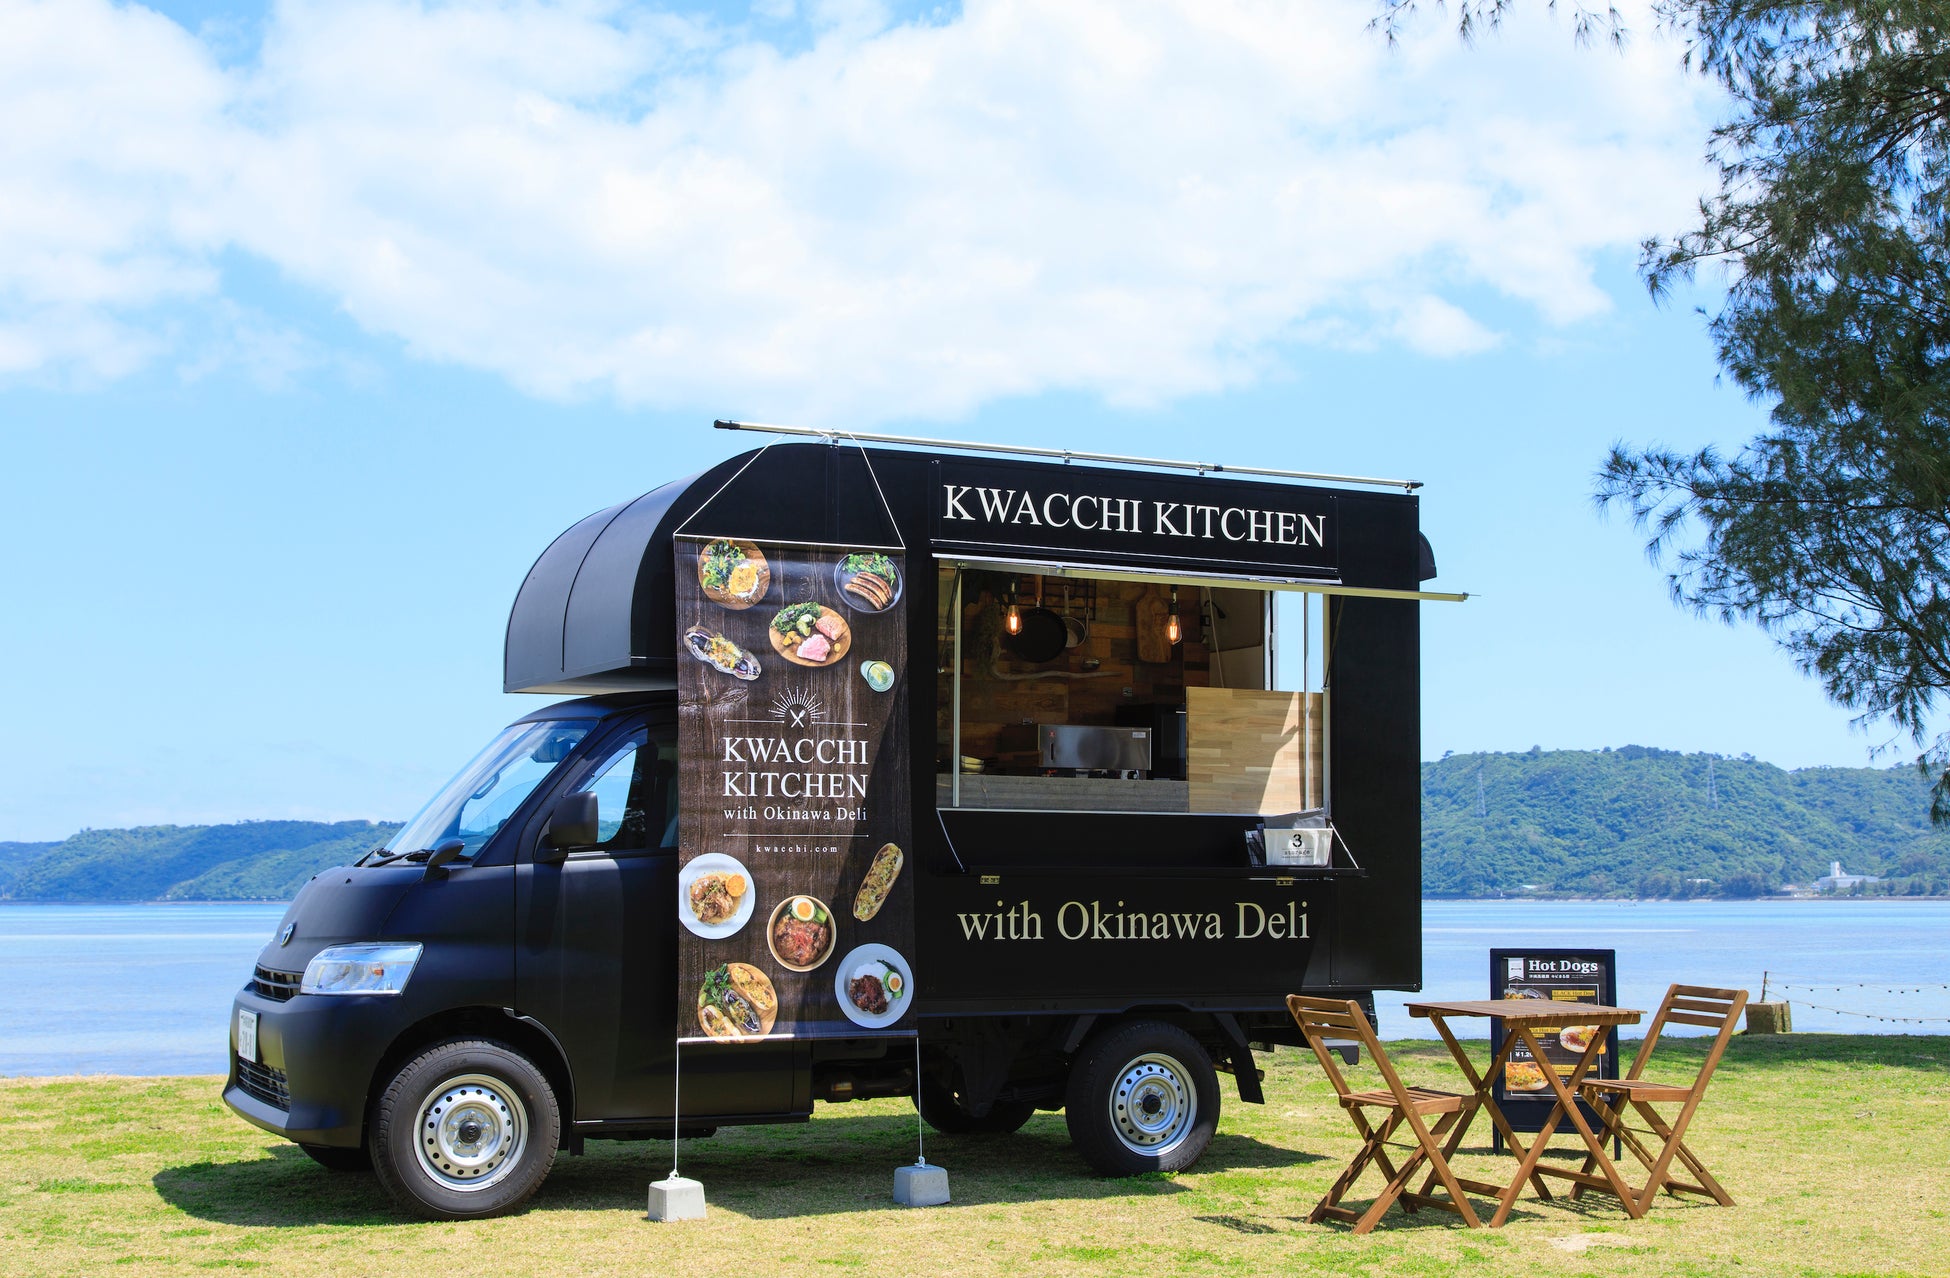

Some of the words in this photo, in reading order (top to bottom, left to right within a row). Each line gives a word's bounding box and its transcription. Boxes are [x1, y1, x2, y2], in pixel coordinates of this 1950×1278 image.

[943, 485, 1143, 533] KWACCHI
[1153, 501, 1327, 548] KITCHEN
[722, 736, 869, 765] KWACCHI
[722, 771, 868, 799] KITCHEN
[724, 805, 757, 820] with
[763, 806, 830, 821] Okinawa
[836, 807, 867, 821] Deli
[756, 844, 838, 853] kwacchi.com
[1292, 833, 1303, 848] 3
[957, 900, 1044, 940] with
[1057, 901, 1225, 940] Okinawa
[1235, 901, 1310, 940] Deli
[1528, 960, 1556, 971] Hot
[1559, 960, 1598, 974] Dogs
